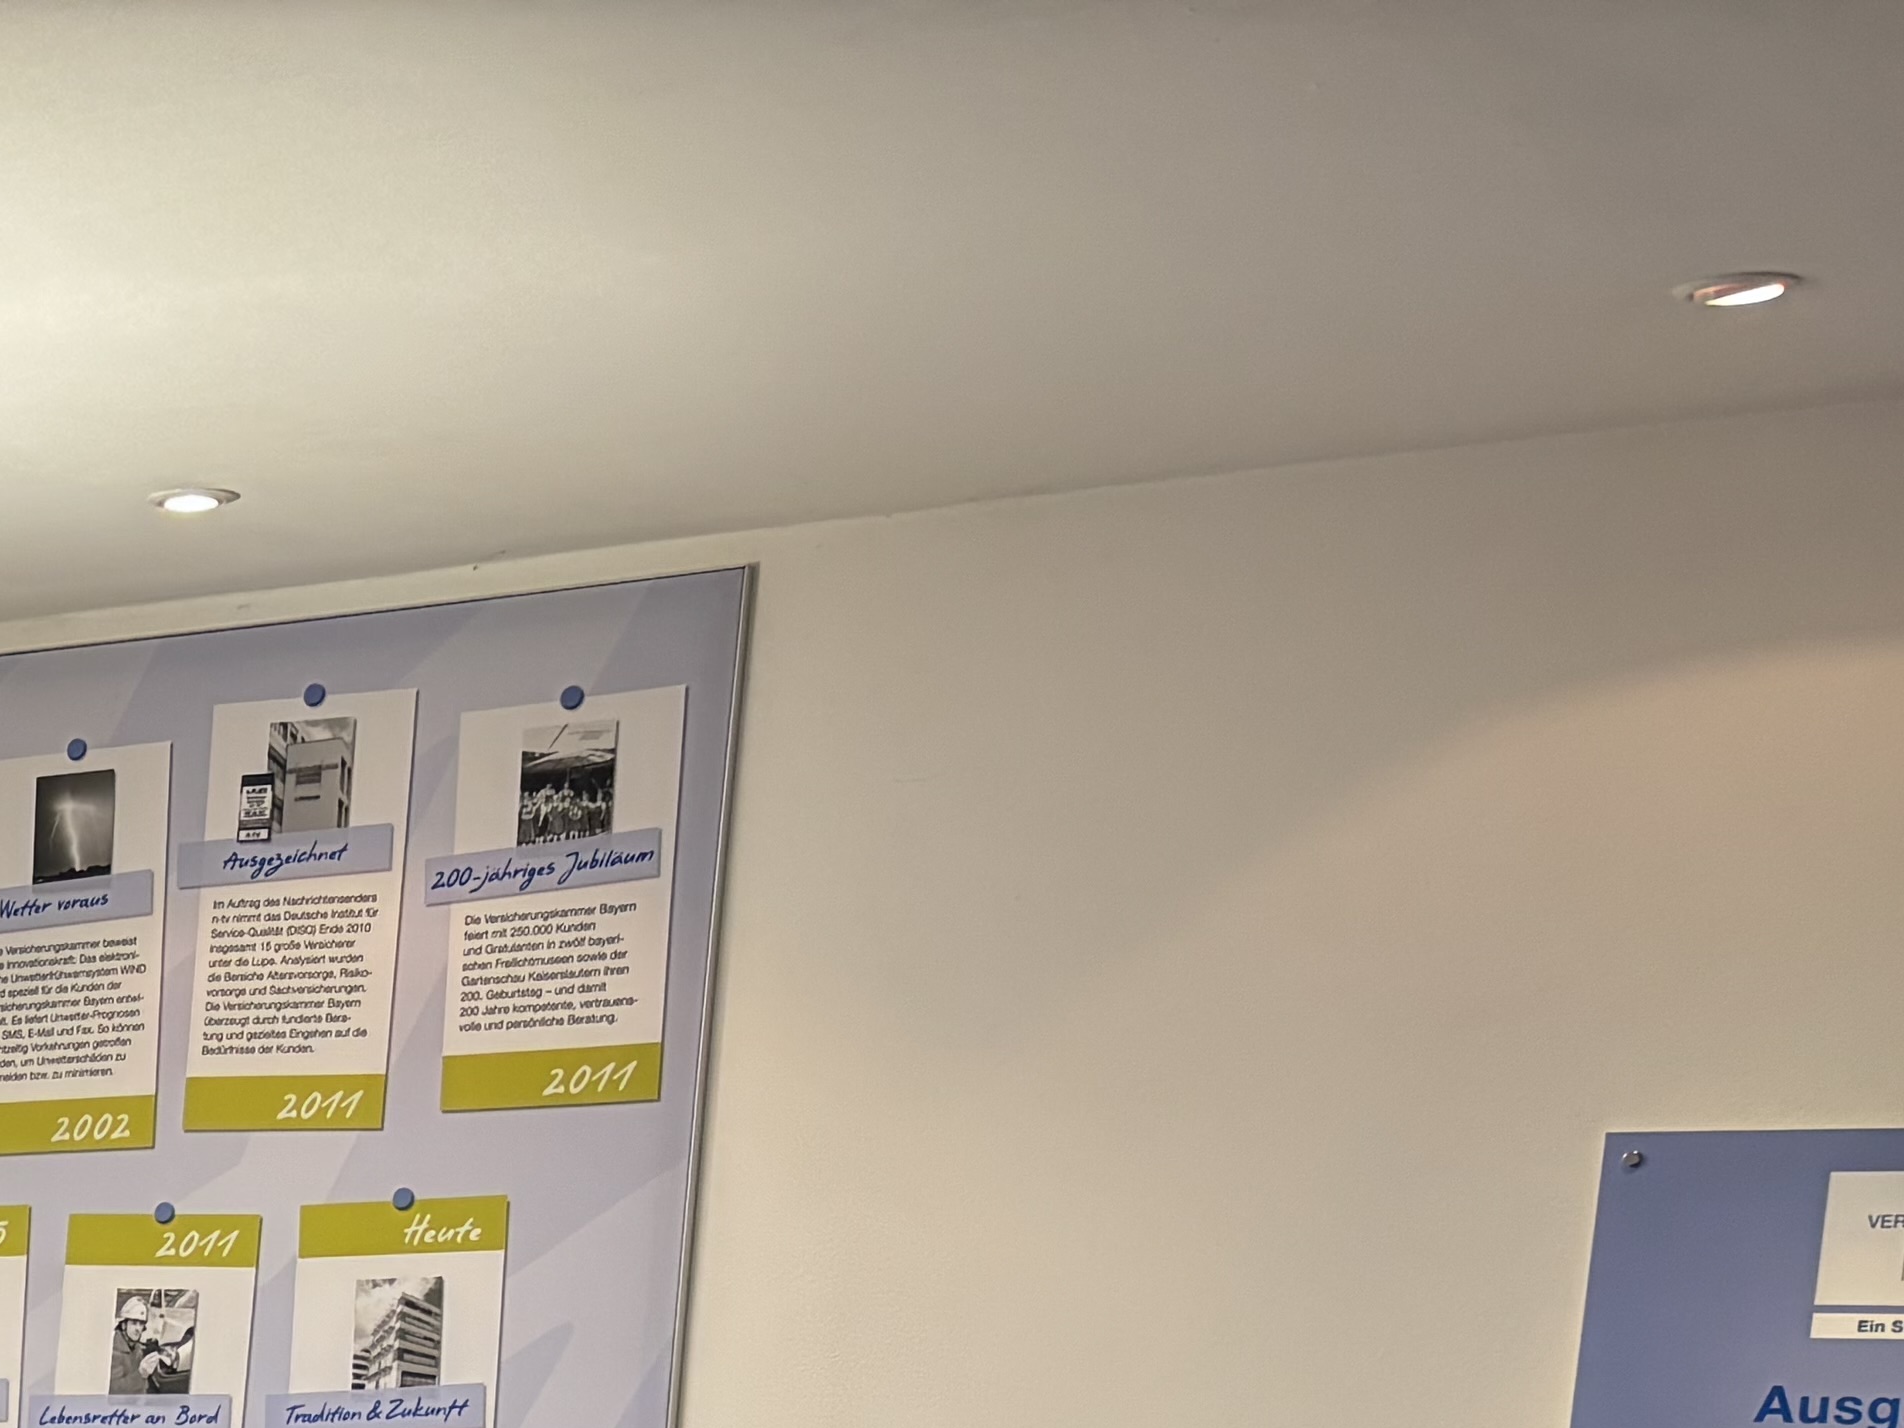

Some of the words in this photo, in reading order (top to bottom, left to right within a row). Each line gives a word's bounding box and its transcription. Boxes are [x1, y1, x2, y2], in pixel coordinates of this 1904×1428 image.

[223, 840, 348, 879] Ausgezeichnet
[431, 858, 555, 893] 200-jähriges
[560, 848, 654, 884] Jubiläum
[0, 899, 52, 918] Wetter
[58, 894, 108, 910] voraus
[543, 1061, 637, 1095] 2011
[277, 1091, 363, 1119] 2011
[51, 1114, 130, 1141] 2002
[156, 1230, 239, 1257] 2011
[404, 1214, 481, 1245] Heute
[1857, 1320, 1885, 1333] Ein
[39, 1406, 140, 1425] Lebensretter
[145, 1415, 165, 1424] an
[175, 1405, 221, 1425] Bord
[286, 1403, 361, 1425] Tradition
[366, 1400, 382, 1421] &
[386, 1397, 469, 1422] Zukunft
